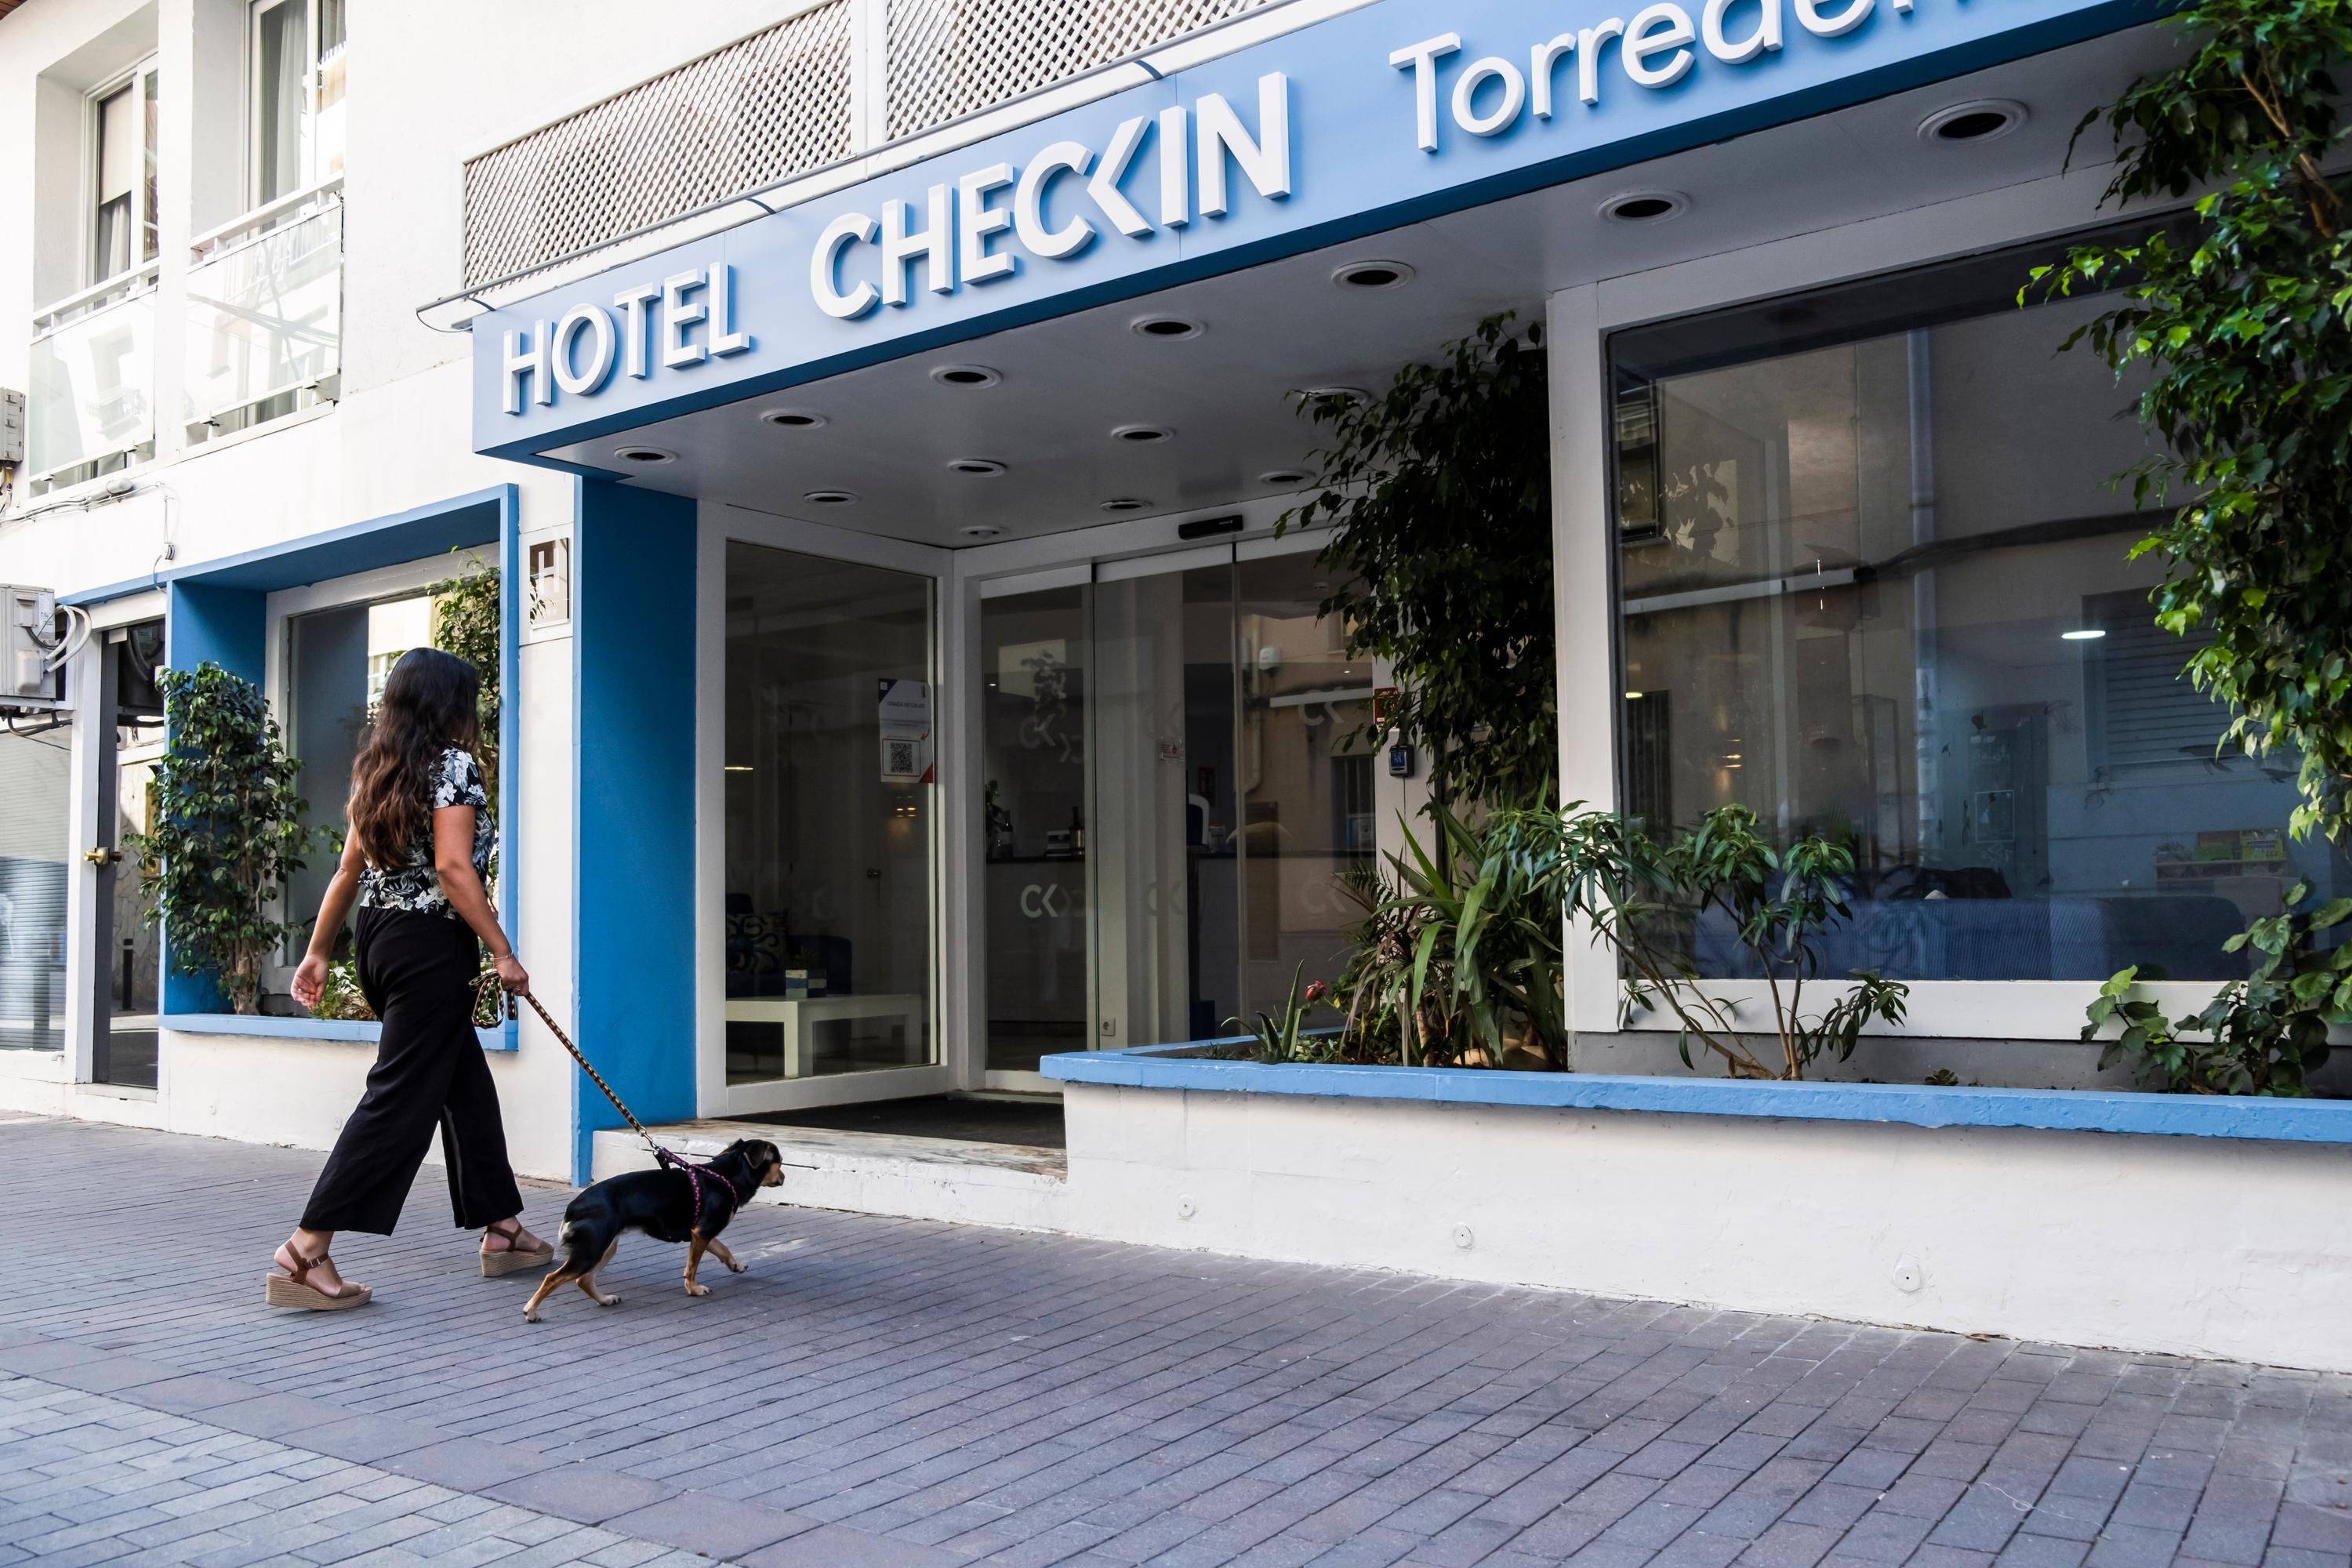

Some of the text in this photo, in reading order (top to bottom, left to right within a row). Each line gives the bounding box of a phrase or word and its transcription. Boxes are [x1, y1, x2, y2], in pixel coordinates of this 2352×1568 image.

[503, 0, 1914, 416] HOTEL CHECKIN Torred
[538, 548, 560, 595] H
[1021, 884, 1058, 919] CK
